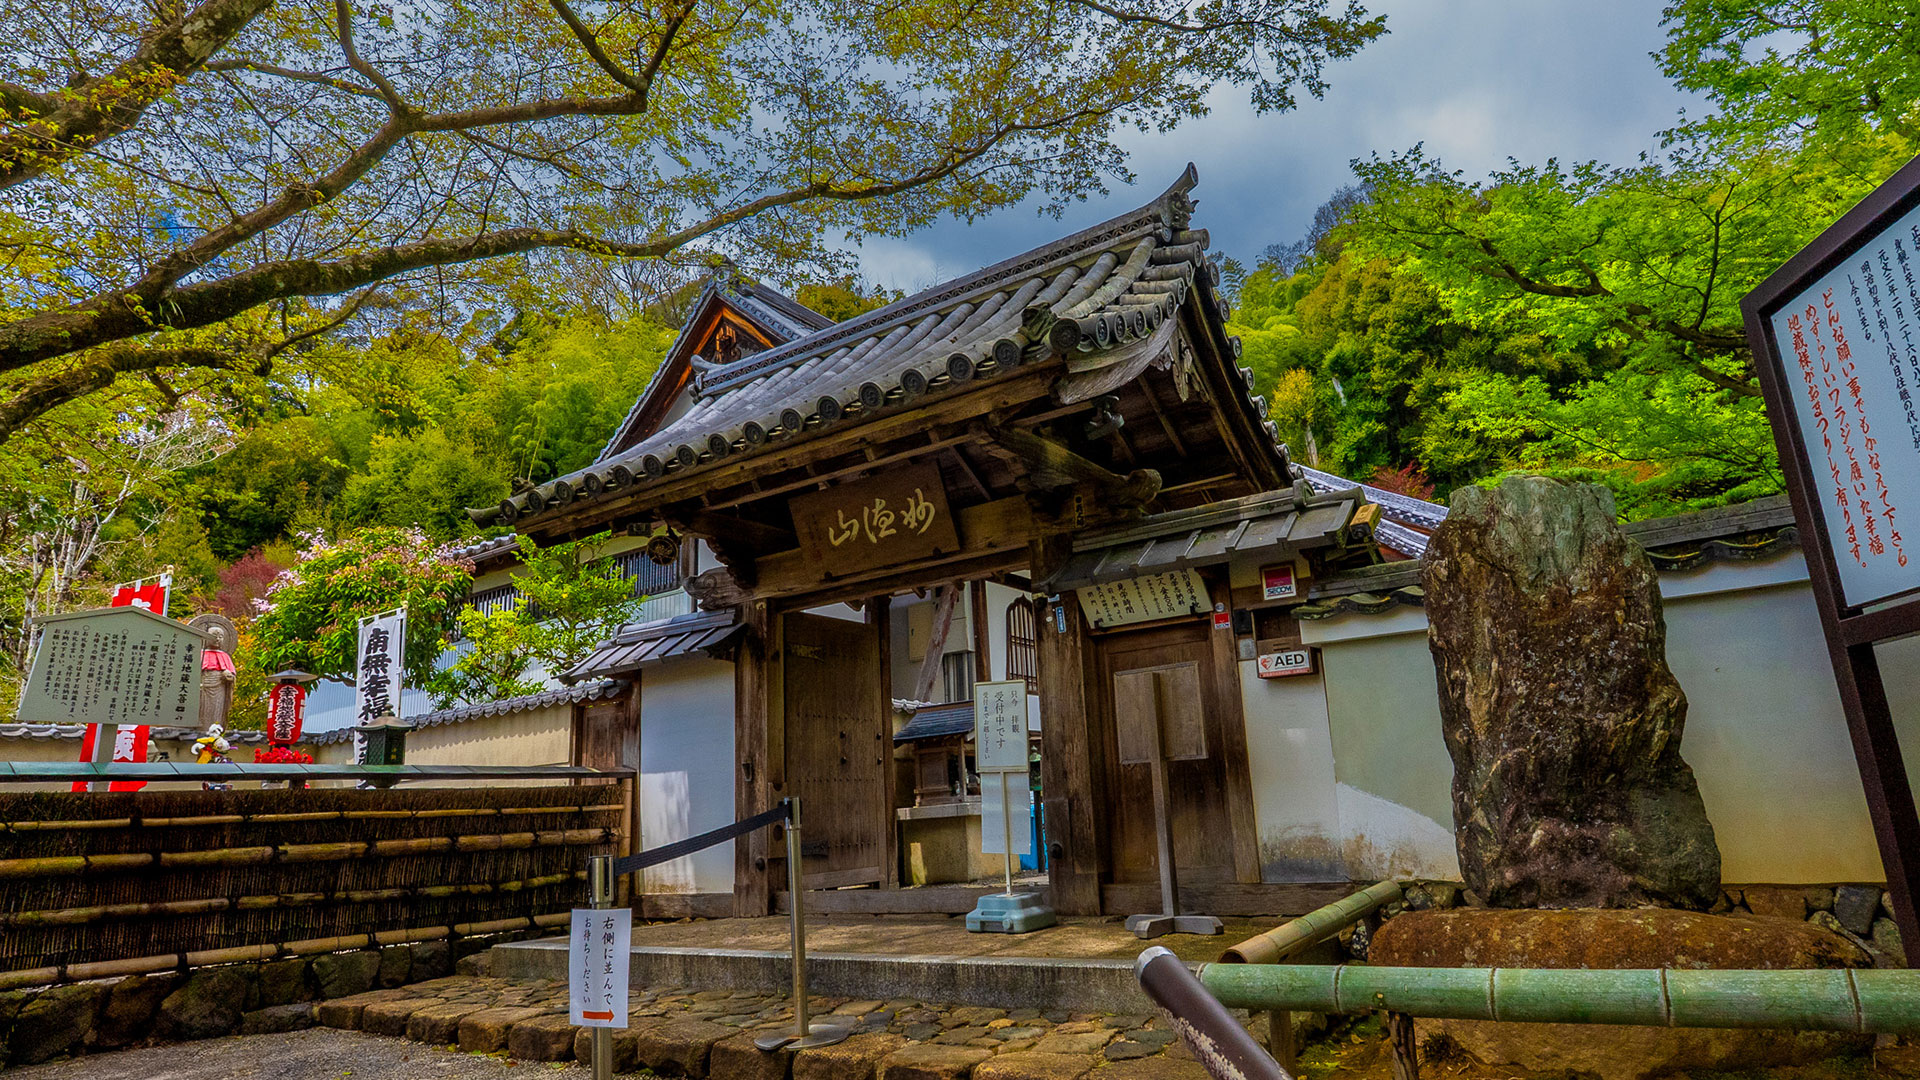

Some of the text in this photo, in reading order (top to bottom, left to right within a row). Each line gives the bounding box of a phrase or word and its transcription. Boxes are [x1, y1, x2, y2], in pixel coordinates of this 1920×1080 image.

[1804, 303, 1885, 556] めずらしいワラジを履いた幸福
[1822, 287, 1908, 568] どんな願い事でもかなえて下さる
[1267, 586, 1292, 595] SECOM
[1275, 654, 1305, 667] AED
[994, 691, 1006, 750] 受付中です
[583, 916, 592, 1004] お待ちください
[602, 916, 615, 1006] 右側に並んで
